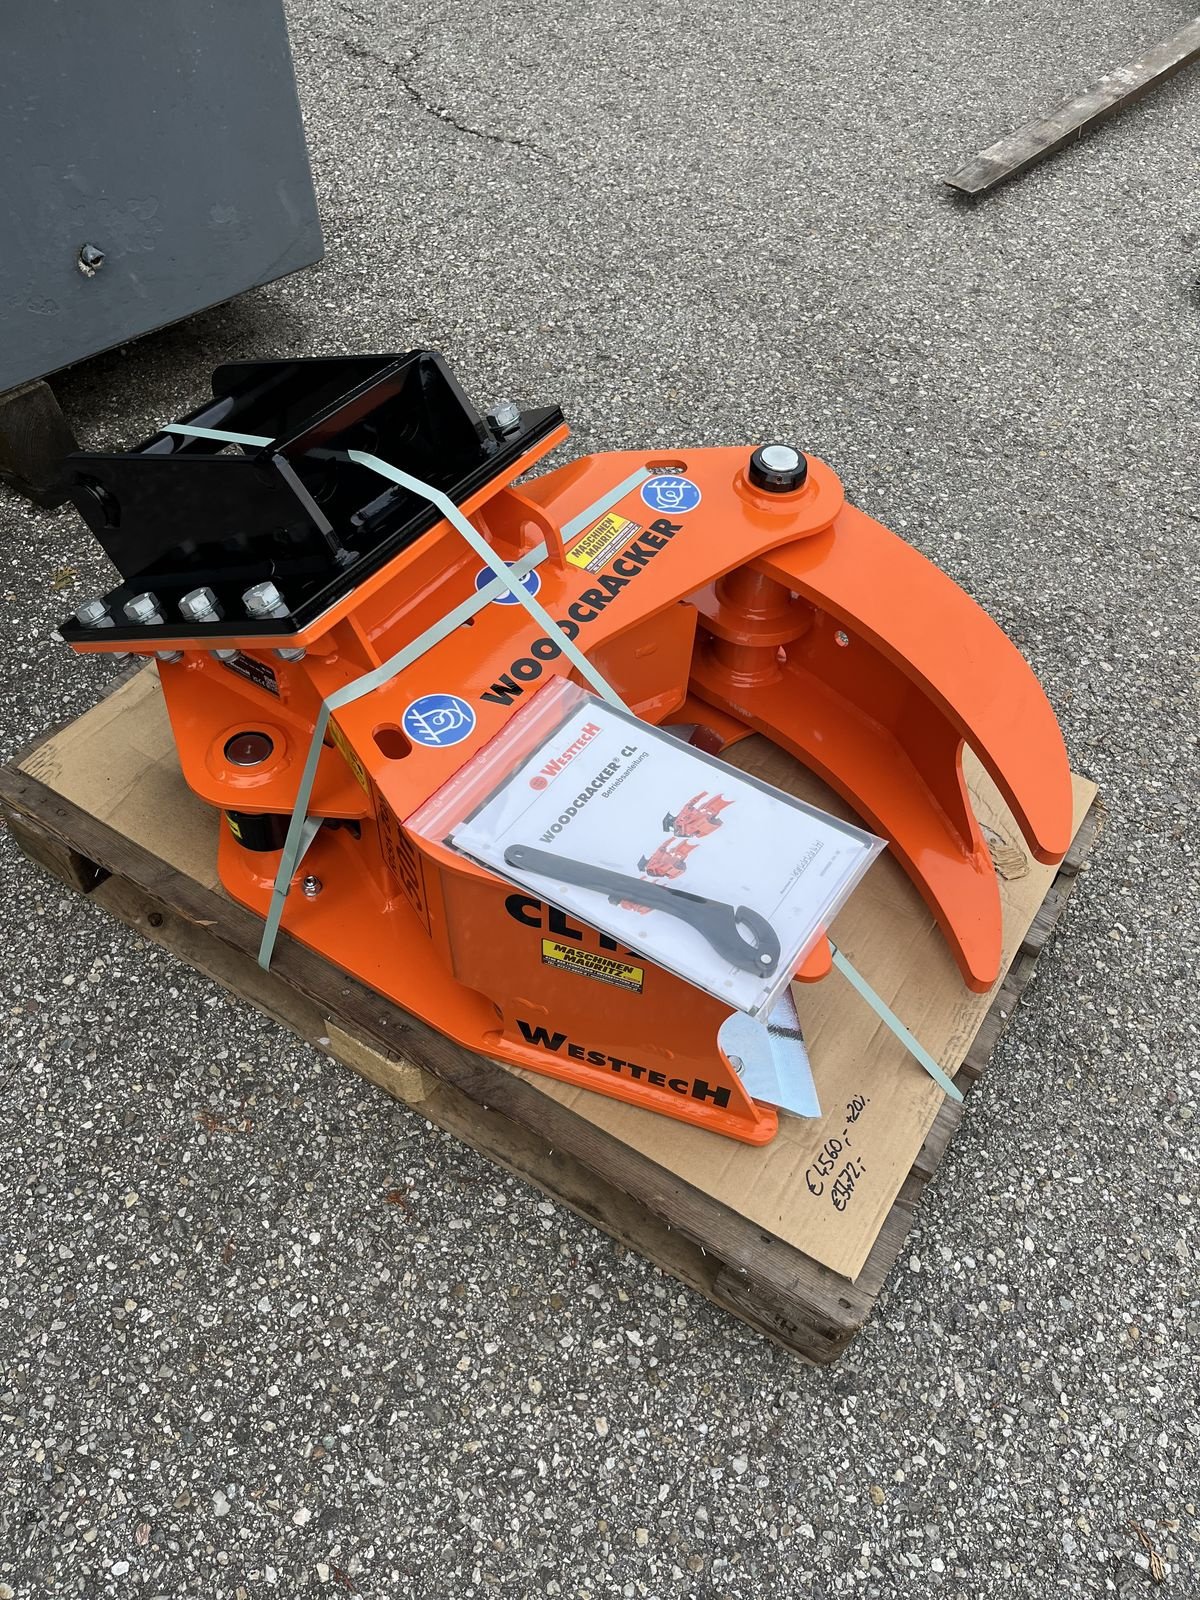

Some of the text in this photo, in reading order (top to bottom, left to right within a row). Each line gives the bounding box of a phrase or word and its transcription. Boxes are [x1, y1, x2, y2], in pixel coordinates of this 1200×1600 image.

[572, 517, 615, 559] MASCHINEN
[585, 526, 619, 559] MAURITZ
[620, 745, 638, 758] CL
[601, 751, 649, 799] Betriebsanleitung
[504, 894, 583, 941] CL
[553, 944, 634, 974] MASCHINEN
[563, 954, 625, 978] MAURITZ
